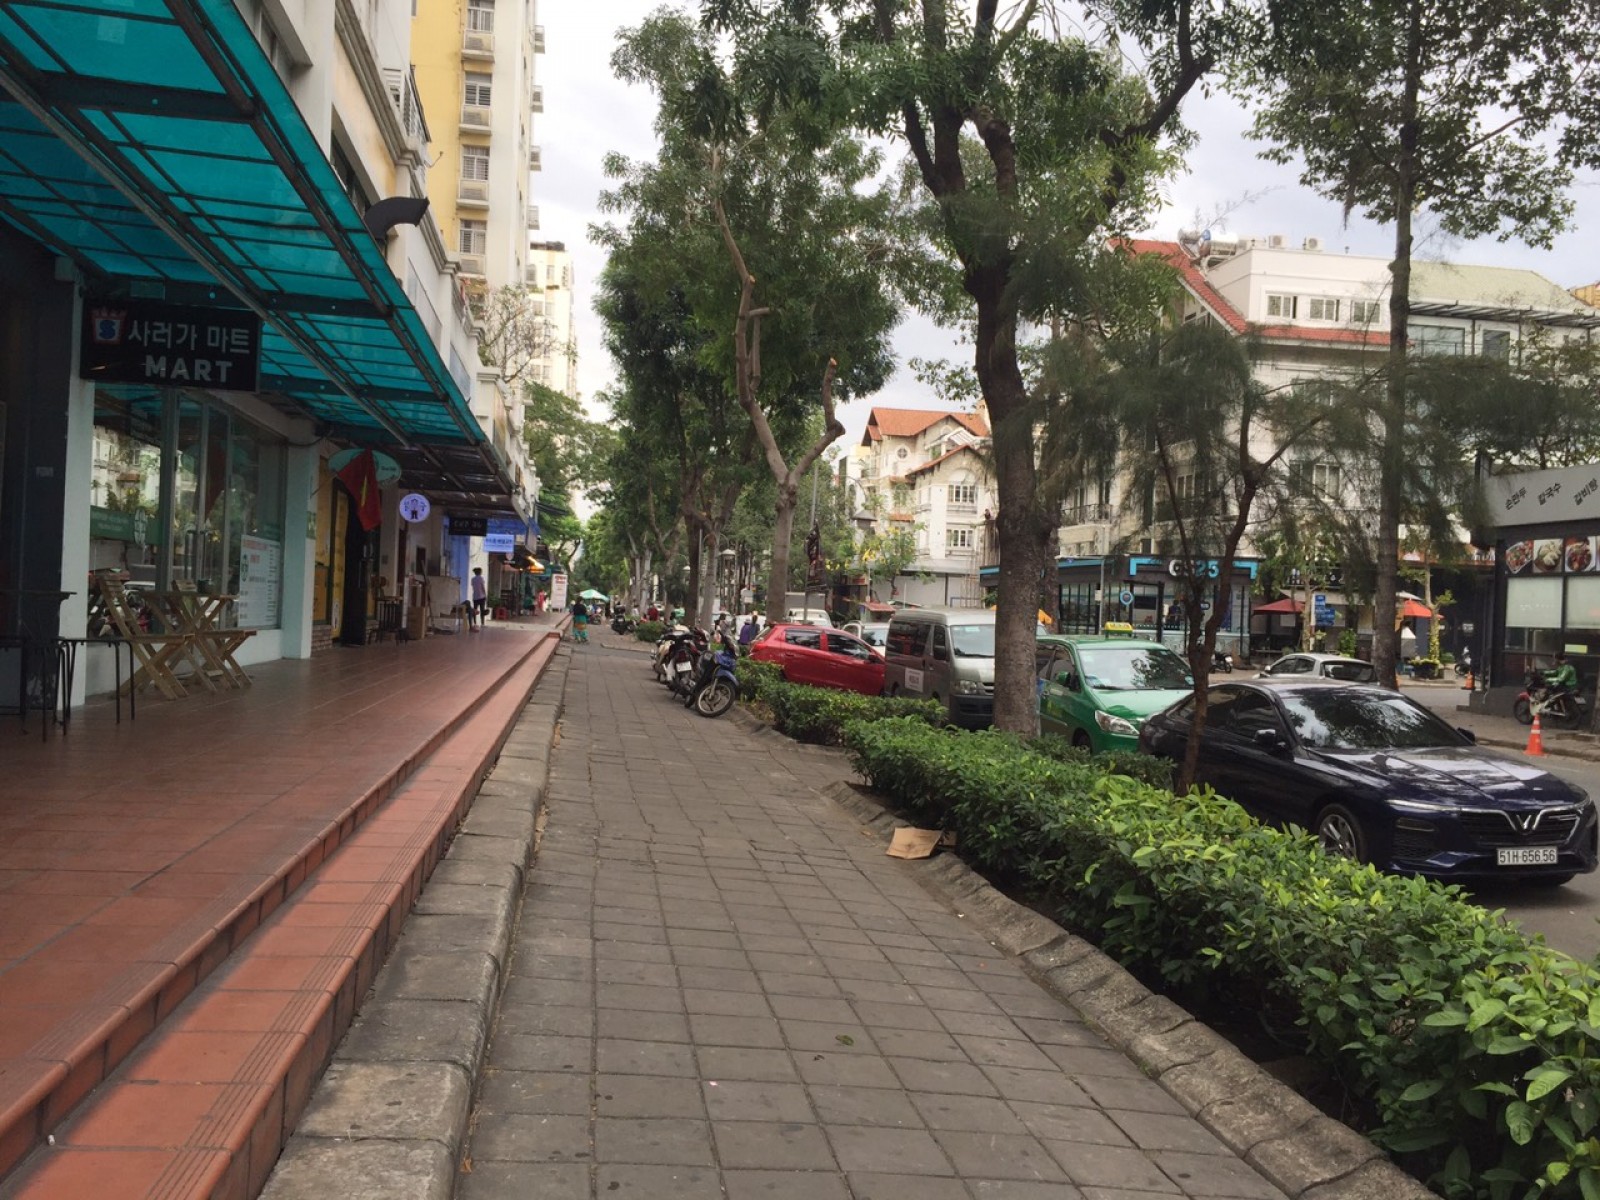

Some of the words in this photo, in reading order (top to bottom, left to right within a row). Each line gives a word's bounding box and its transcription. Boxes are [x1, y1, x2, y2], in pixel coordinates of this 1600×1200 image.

[128, 319, 198, 351] 사러가
[207, 326, 250, 354] 마트
[145, 354, 234, 383] MART
[1505, 486, 1527, 510] 손만두
[1538, 482, 1562, 506] 칼국수
